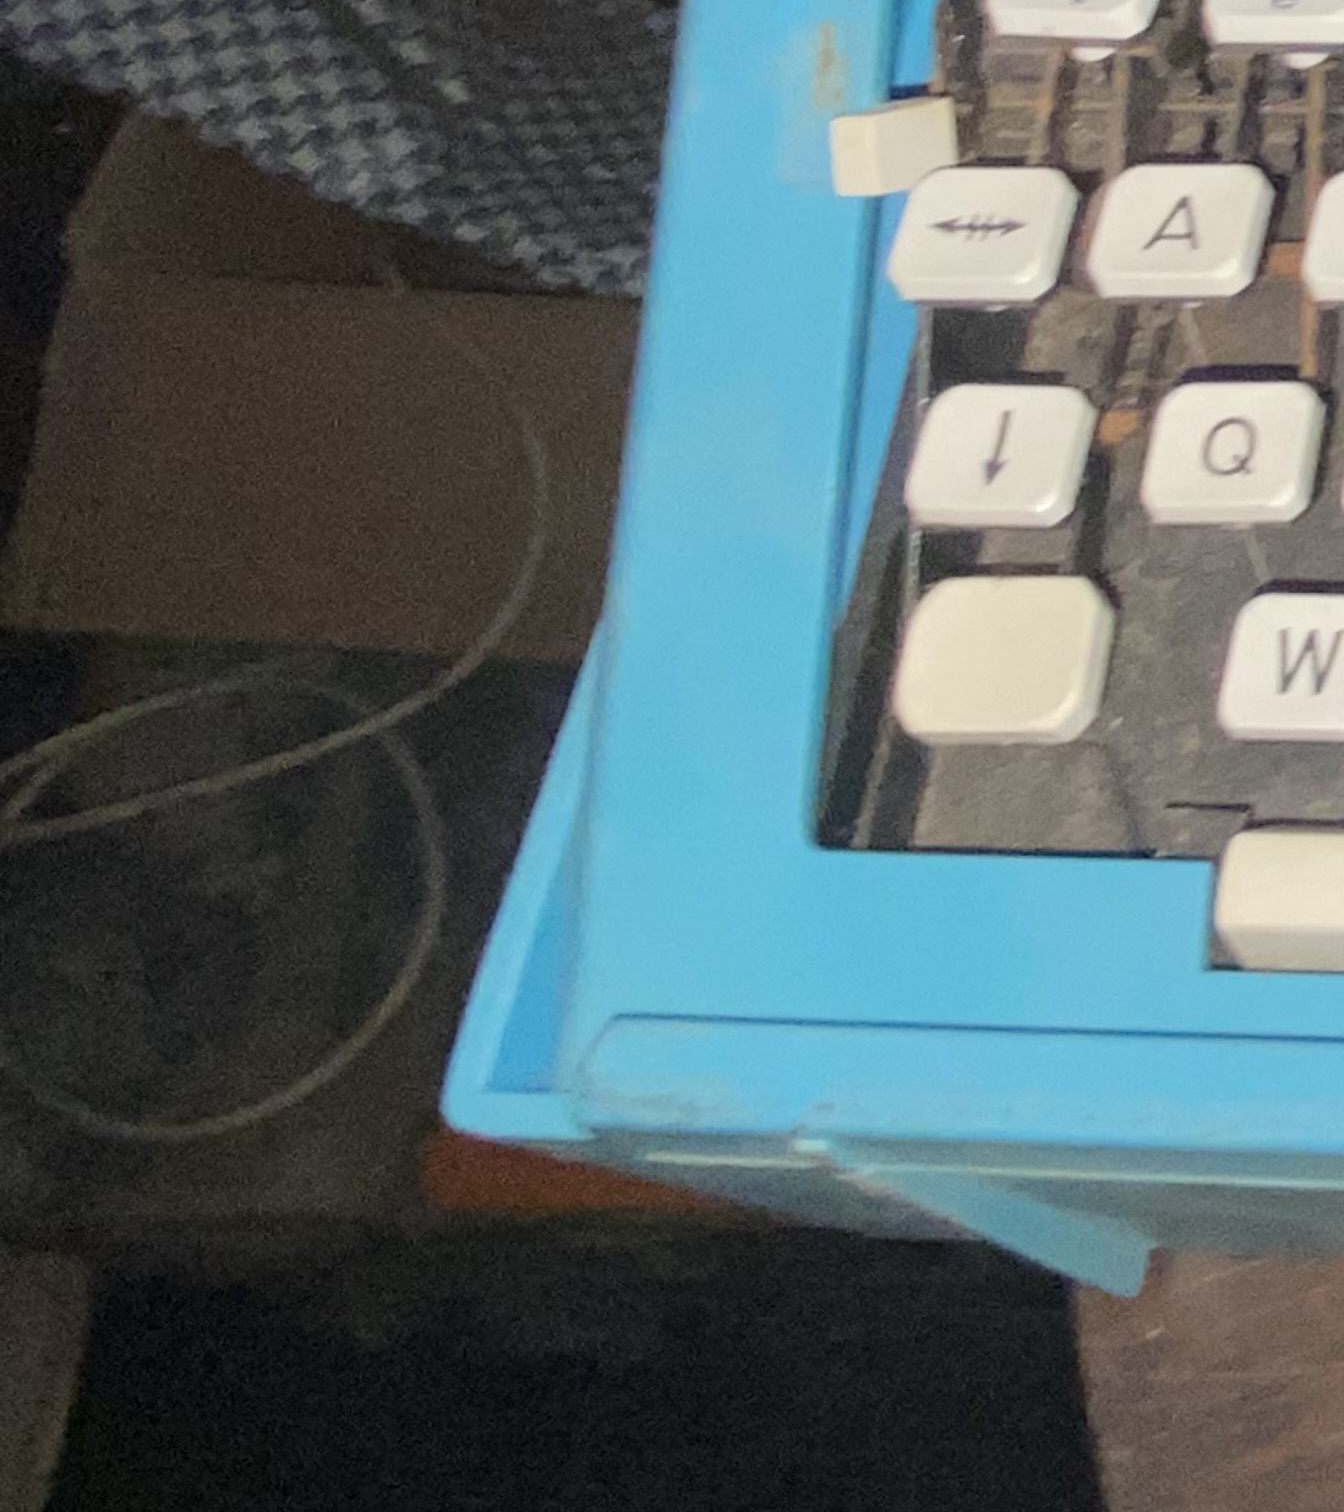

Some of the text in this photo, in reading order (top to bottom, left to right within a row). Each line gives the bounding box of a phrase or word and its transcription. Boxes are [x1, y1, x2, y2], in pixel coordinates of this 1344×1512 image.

[1143, 195, 1198, 250] A
[1201, 416, 1257, 477] Q
[1278, 629, 1344, 695] W
